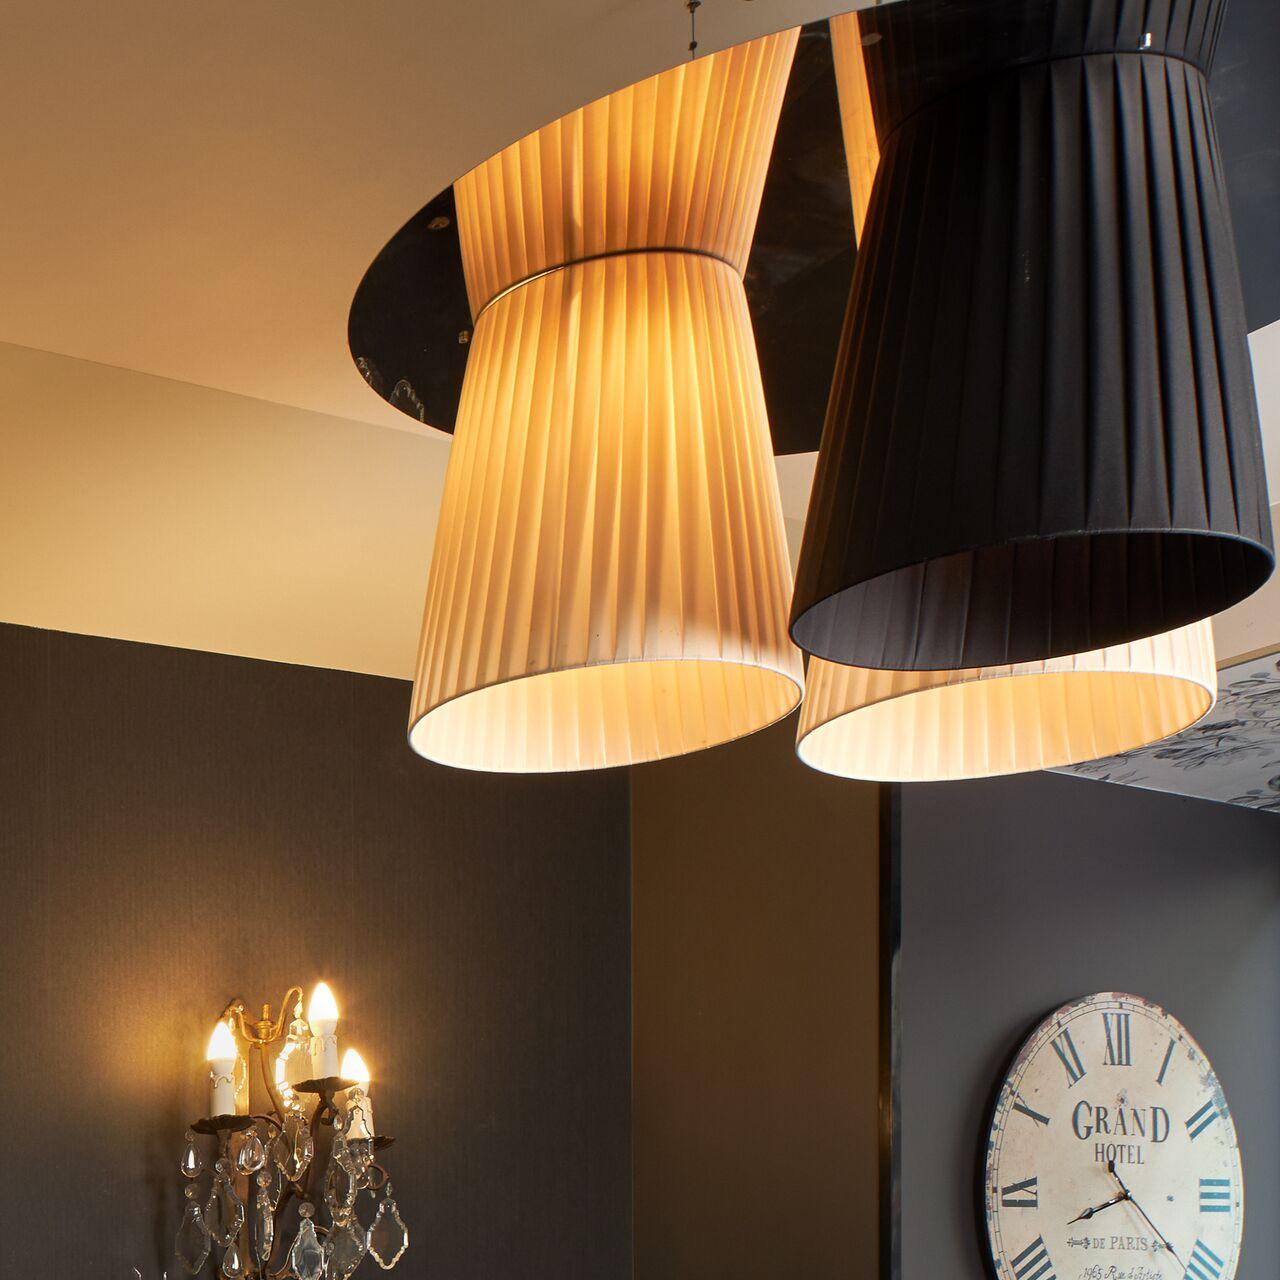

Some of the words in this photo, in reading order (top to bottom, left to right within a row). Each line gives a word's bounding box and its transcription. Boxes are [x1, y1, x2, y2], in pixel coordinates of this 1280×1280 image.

[1050, 1027, 1087, 1088] XI
[1102, 1013, 1131, 1067] XII
[1155, 1038, 1177, 1086] I
[1012, 1090, 1050, 1127] X
[1072, 1100, 1170, 1143] GRAND
[1184, 1099, 1219, 1142] II
[1095, 1143, 1145, 1165] HOTEL
[1001, 1176, 1038, 1208] IX
[1199, 1178, 1231, 1214] III
[1093, 1237, 1106, 1249] DE
[1109, 1236, 1149, 1251] PARIS
[1104, 1265, 1126, 1280] Rue
